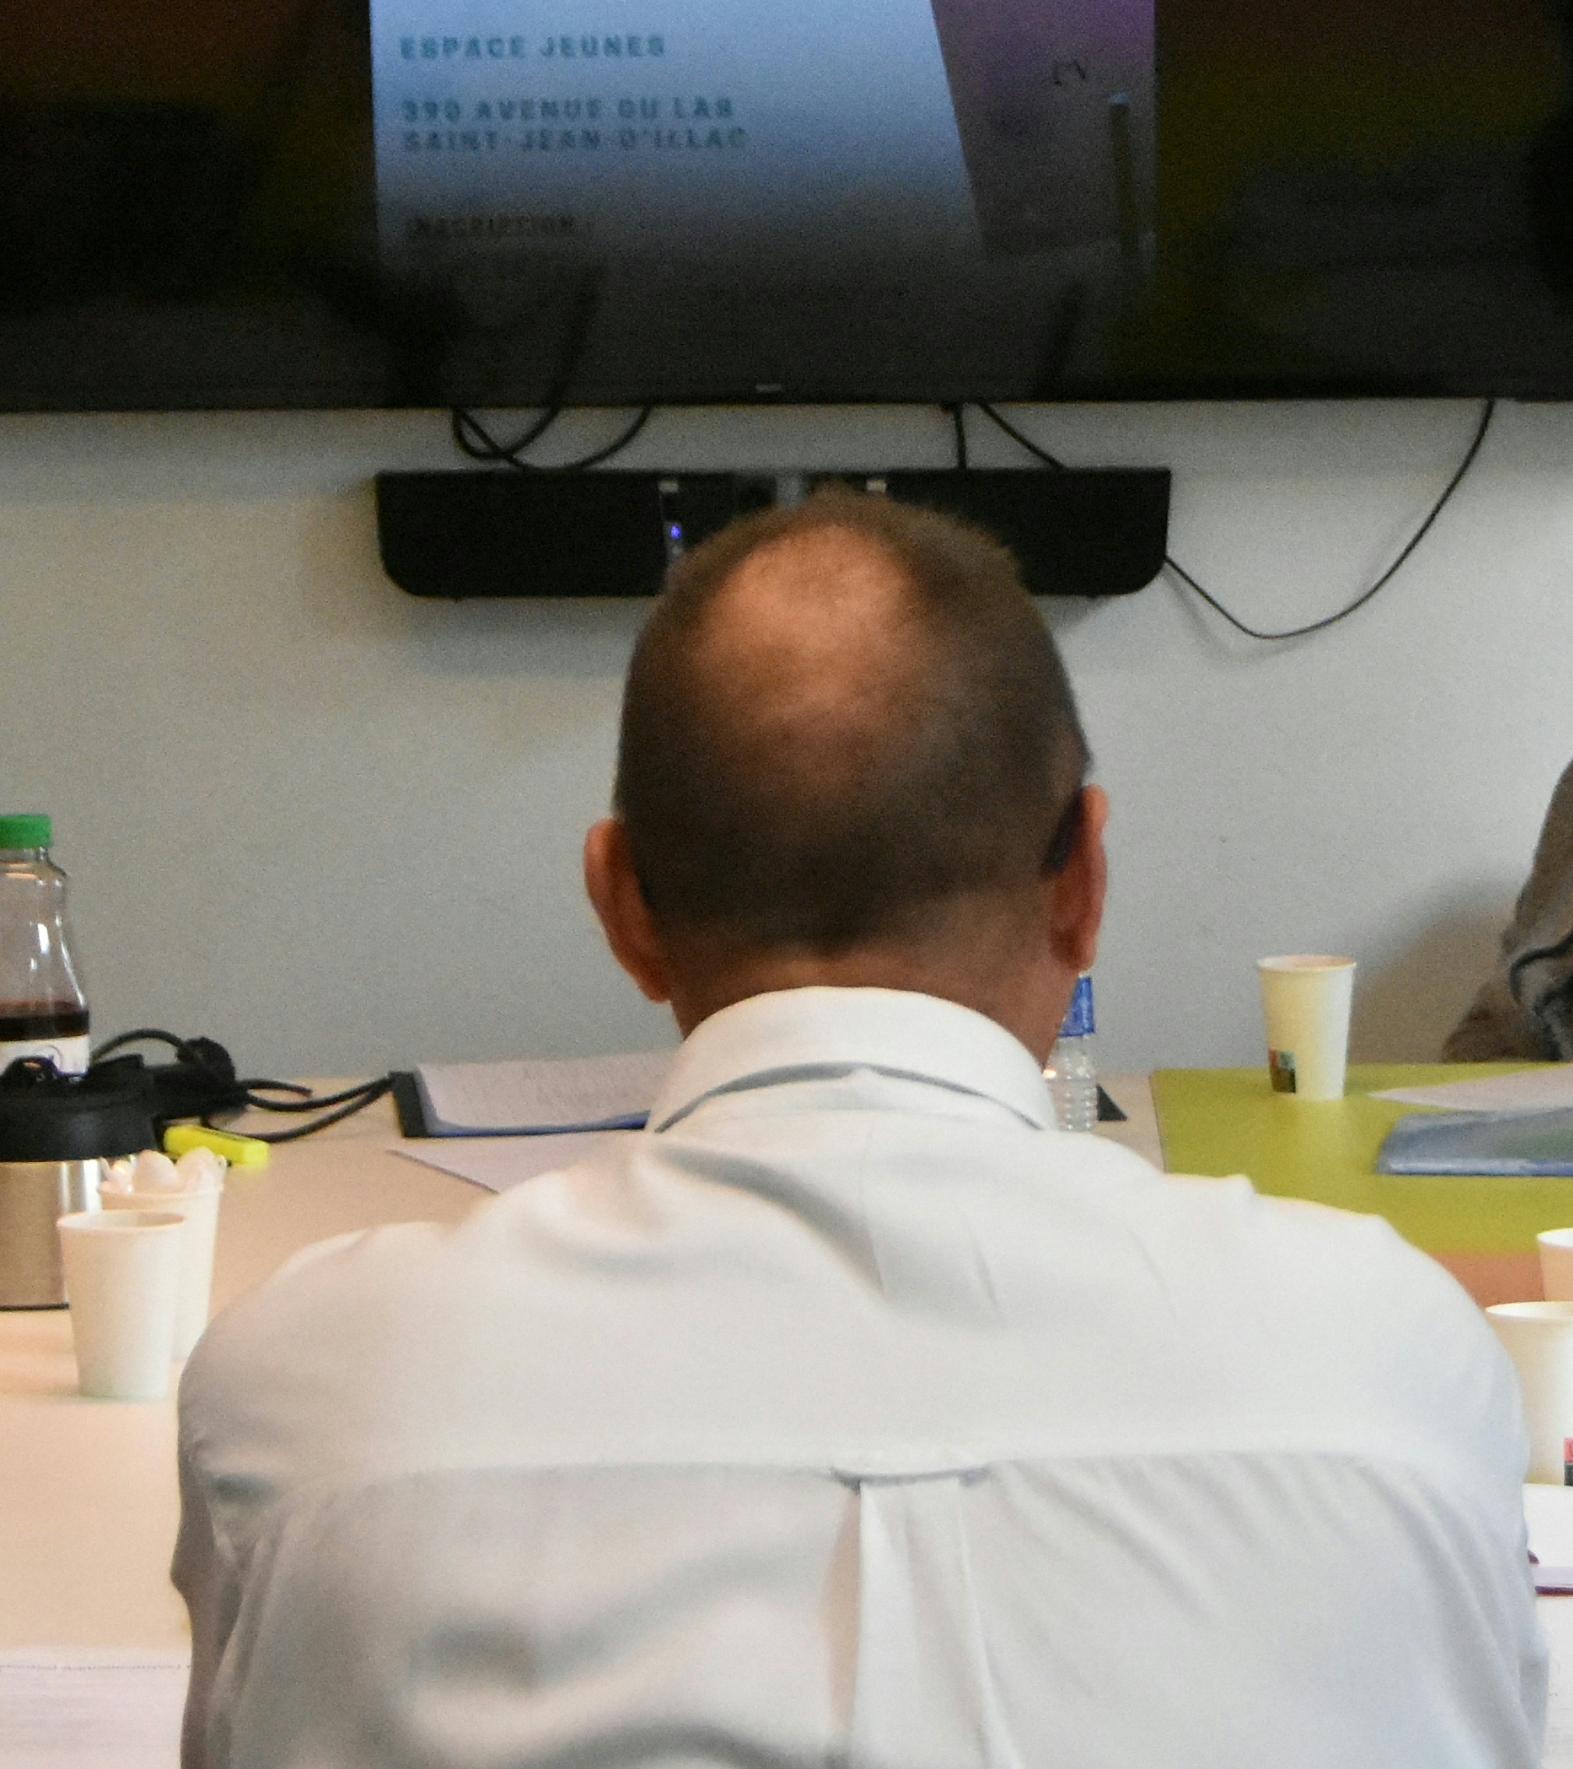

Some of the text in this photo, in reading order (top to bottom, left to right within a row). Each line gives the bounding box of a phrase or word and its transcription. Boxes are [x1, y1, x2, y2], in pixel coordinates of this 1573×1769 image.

[400, 34, 665, 60] ESPACE JEUNES
[476, 97, 600, 122] AVENUE
